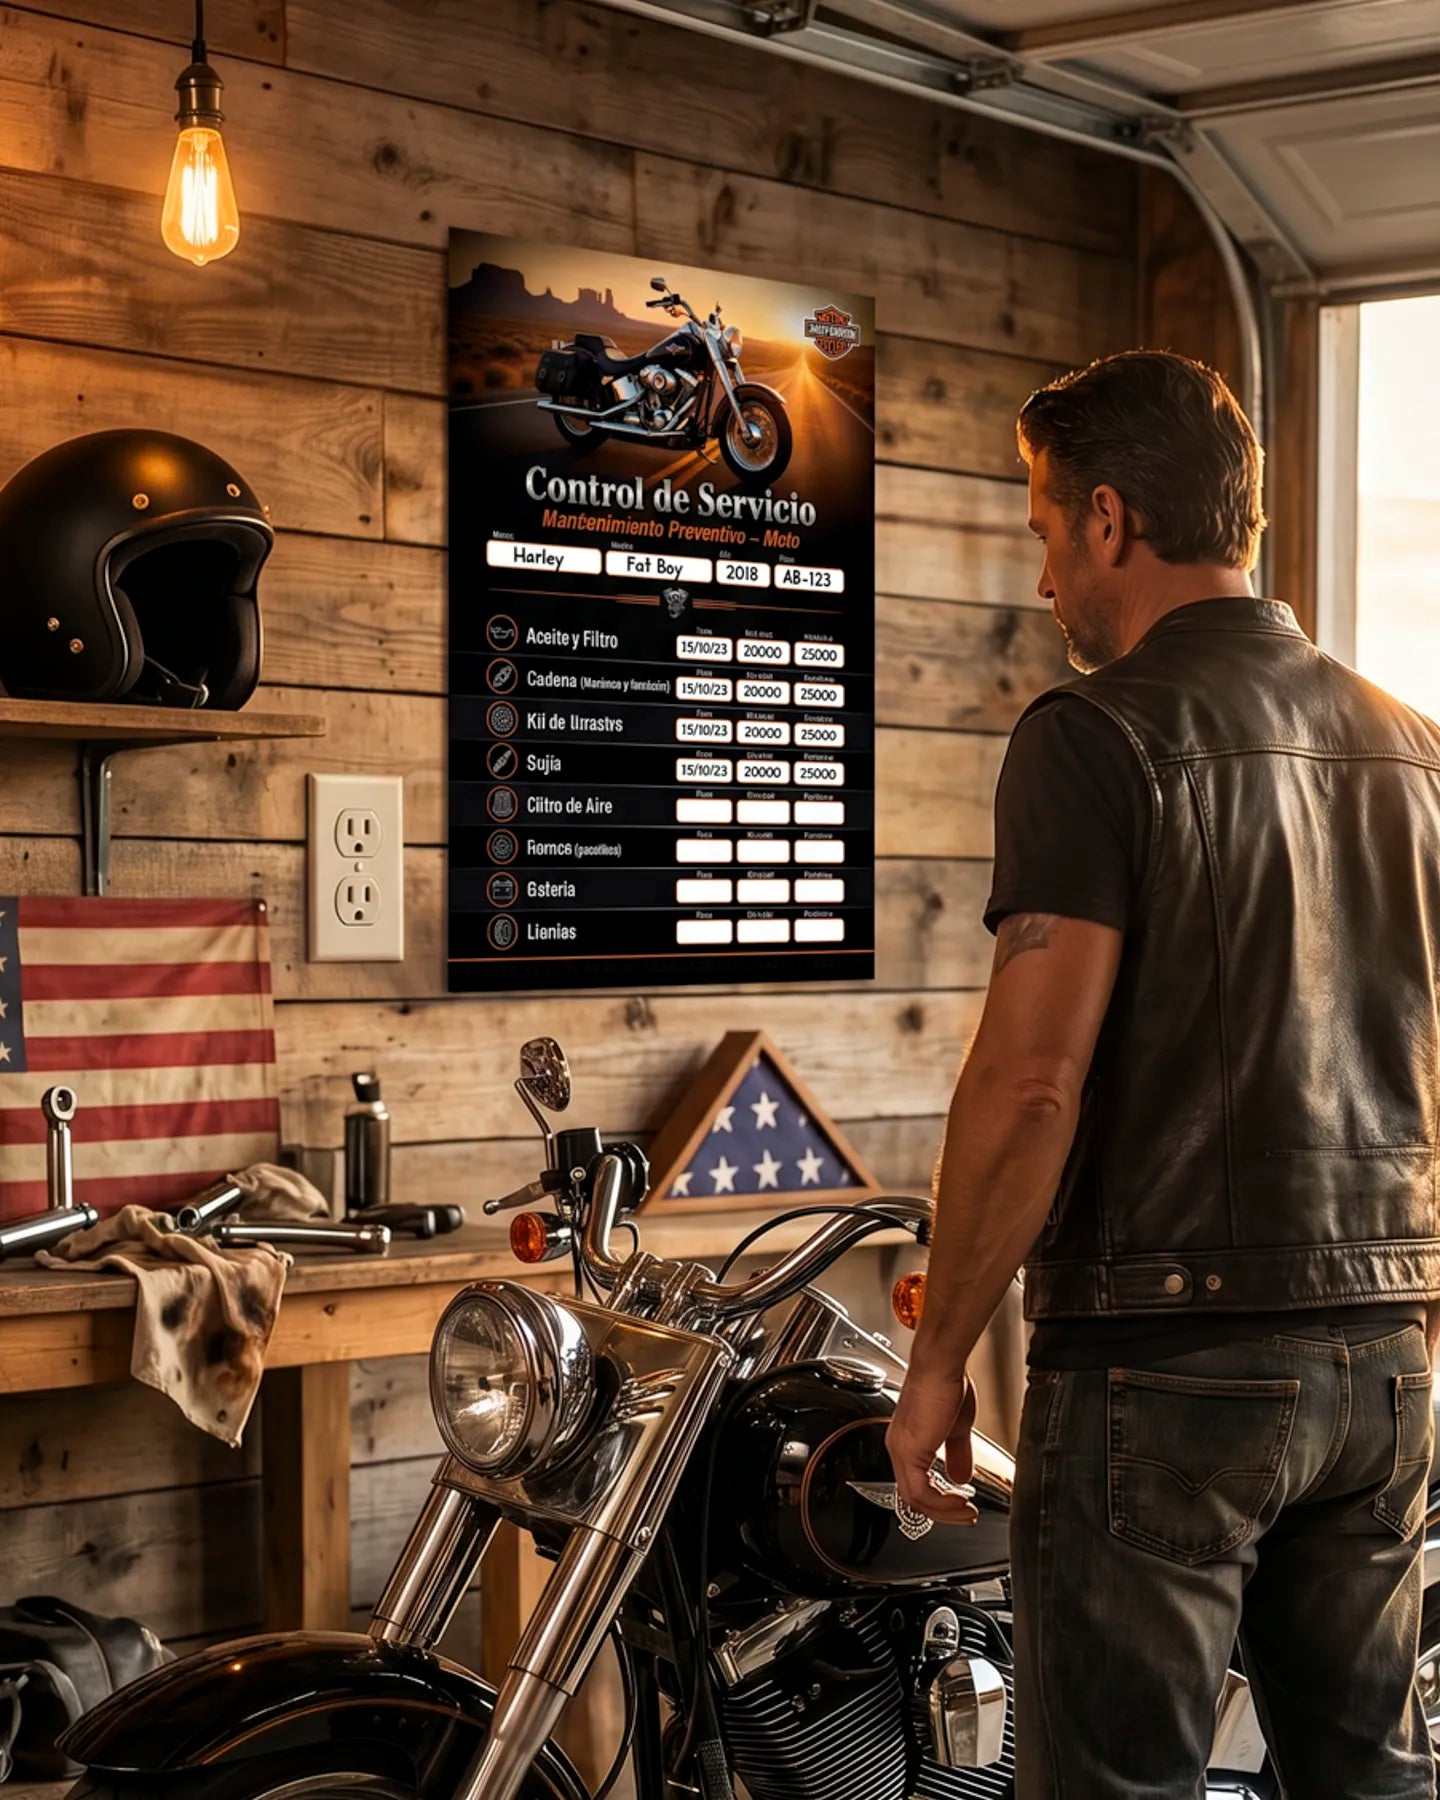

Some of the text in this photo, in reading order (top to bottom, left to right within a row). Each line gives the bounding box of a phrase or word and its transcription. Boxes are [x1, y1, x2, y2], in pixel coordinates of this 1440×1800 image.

[525, 465, 817, 526] Control de Servicio
[668, 520, 747, 545] Preventivo
[513, 546, 564, 572] Harley
[626, 556, 684, 581] Fat Boy
[726, 565, 759, 581] 2018
[783, 569, 831, 587] AB-123
[526, 627, 619, 650] Aceite y Filtro
[681, 641, 728, 656] 15/10/23
[743, 644, 782, 659] 20000
[801, 648, 838, 662] 25000
[527, 670, 577, 688] Cadena
[681, 682, 728, 697] 15/10/23
[743, 685, 782, 699] 20000
[800, 687, 837, 702] 25000
[549, 713, 566, 731] de
[681, 723, 728, 737] 15/10/23
[744, 726, 782, 739] 20000
[800, 729, 837, 742] 25000
[681, 763, 728, 777] 15/10/23
[744, 766, 782, 779] 20000
[800, 768, 837, 780] 25000
[566, 797, 583, 814] de
[586, 797, 613, 814] Aire
